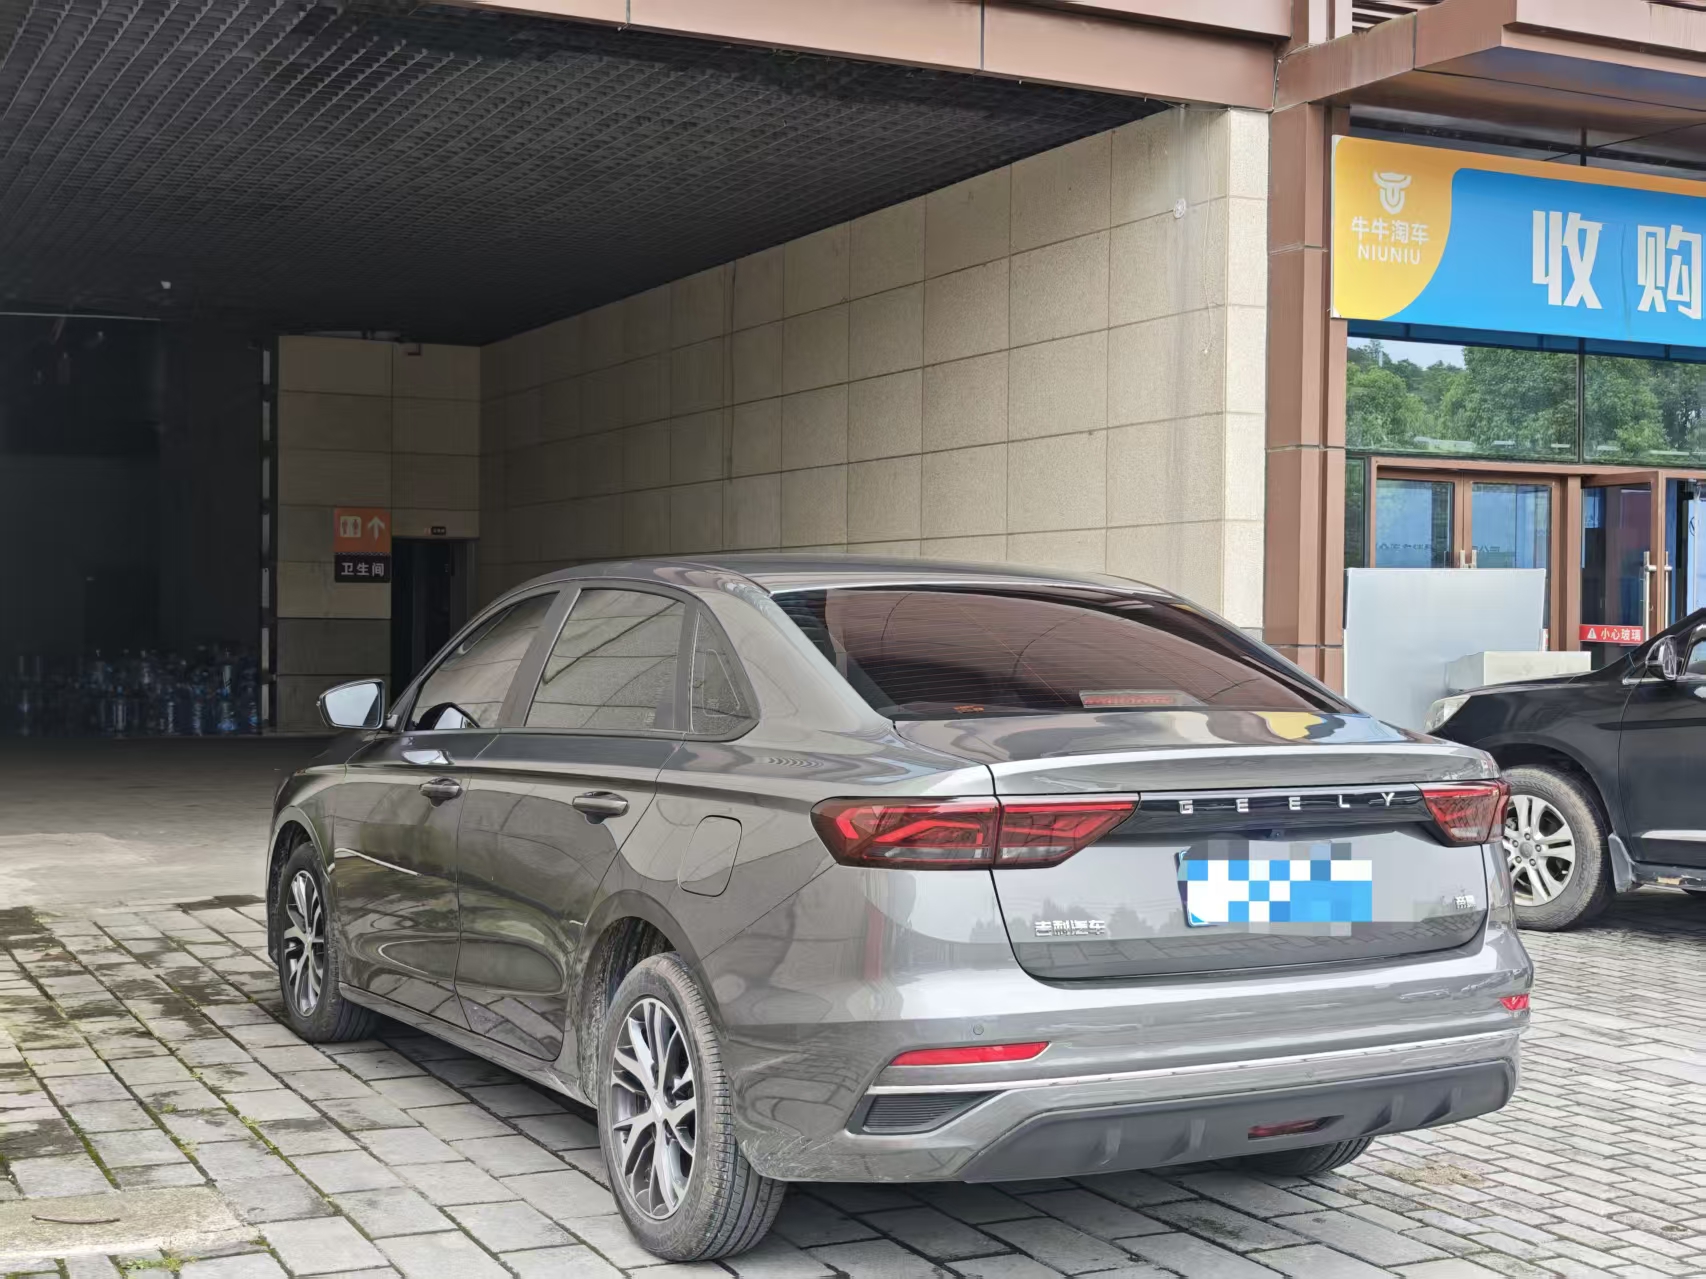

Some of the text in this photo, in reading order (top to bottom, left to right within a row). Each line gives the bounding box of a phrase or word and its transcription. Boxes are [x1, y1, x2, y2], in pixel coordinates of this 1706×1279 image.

[1351, 216, 1430, 245] 牛牛淘车
[1357, 244, 1421, 265] NIUNIU
[340, 561, 385, 577] 卫生间
[1600, 627, 1642, 641] 小心玻璃
[1178, 792, 1395, 814] GEELY
[1034, 920, 1106, 937] 吉利汽车
